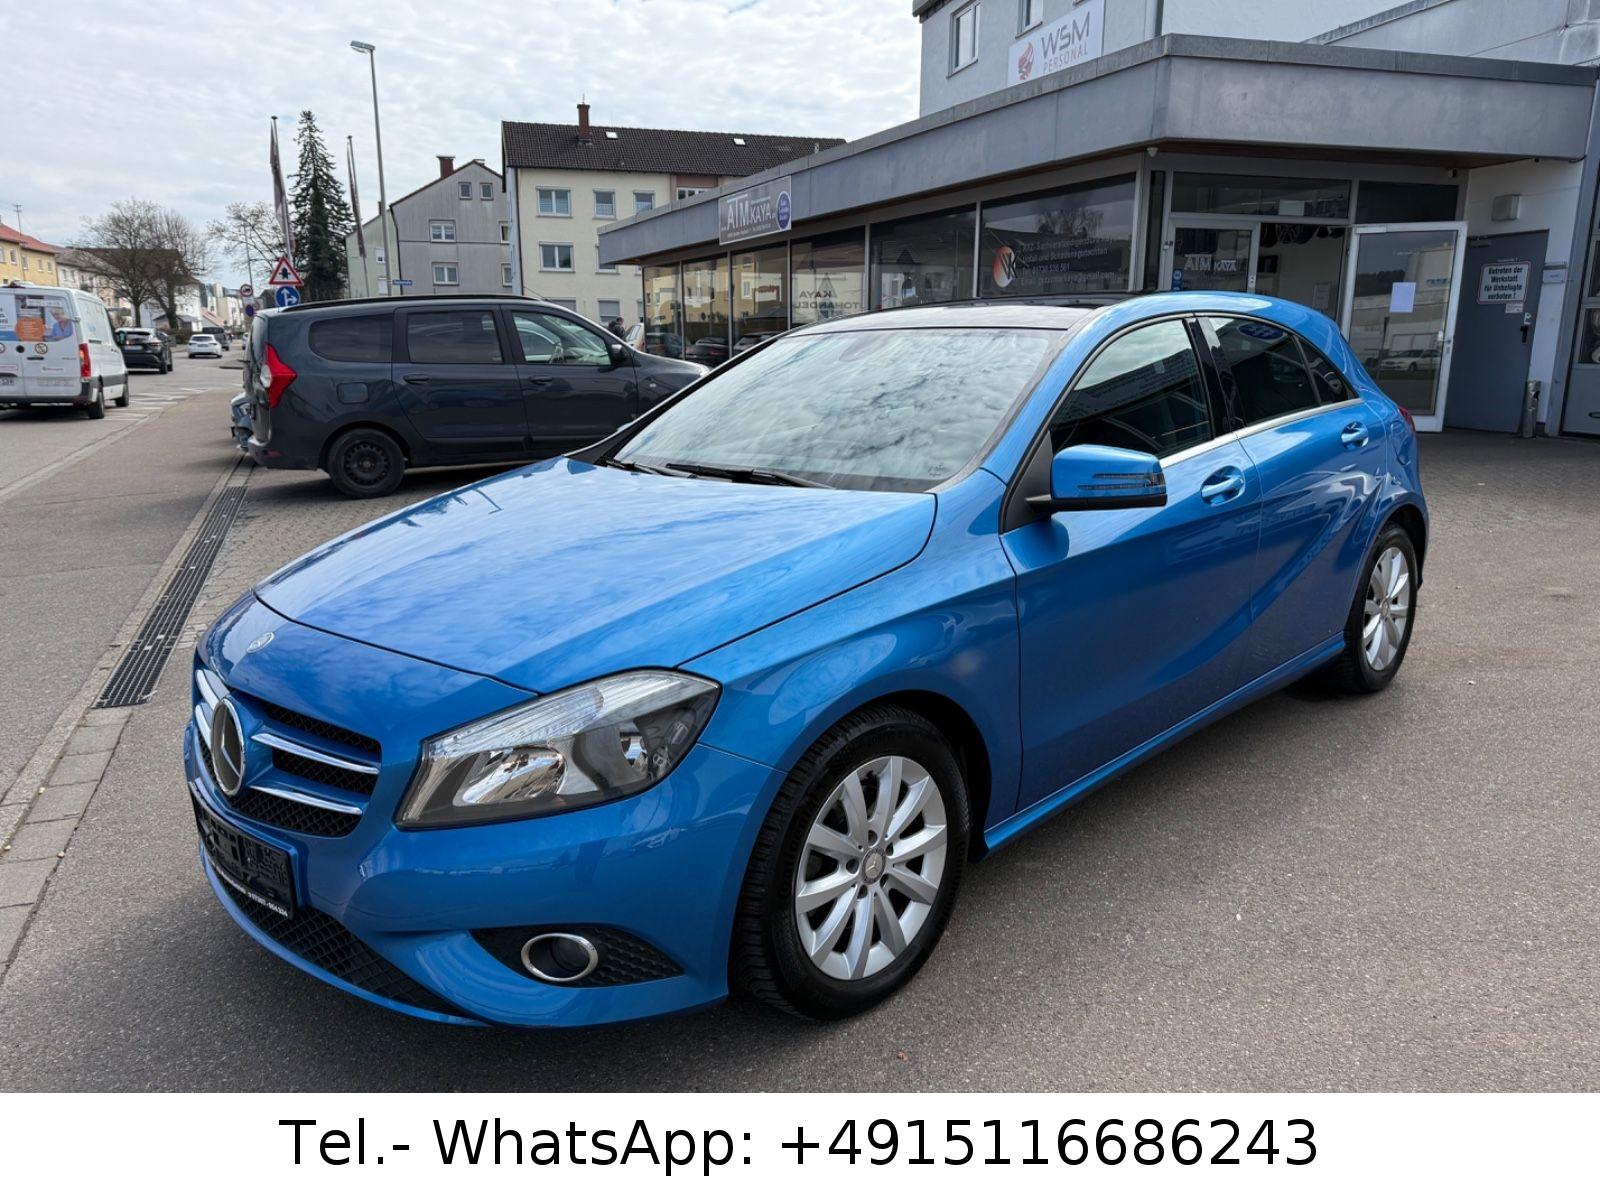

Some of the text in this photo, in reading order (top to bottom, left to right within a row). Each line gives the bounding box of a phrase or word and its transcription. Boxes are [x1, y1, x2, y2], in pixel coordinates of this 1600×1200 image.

[1041, 11, 1090, 59] WSM
[1043, 41, 1089, 75] PERSONAL
[1184, 254, 1238, 271] ATM KAYA
[1488, 266, 1523, 275] Betreten der
[1490, 275, 1518, 283] Werkstatt
[1493, 283, 1523, 293] Unbefugte
[1487, 292, 1512, 300] verboten
